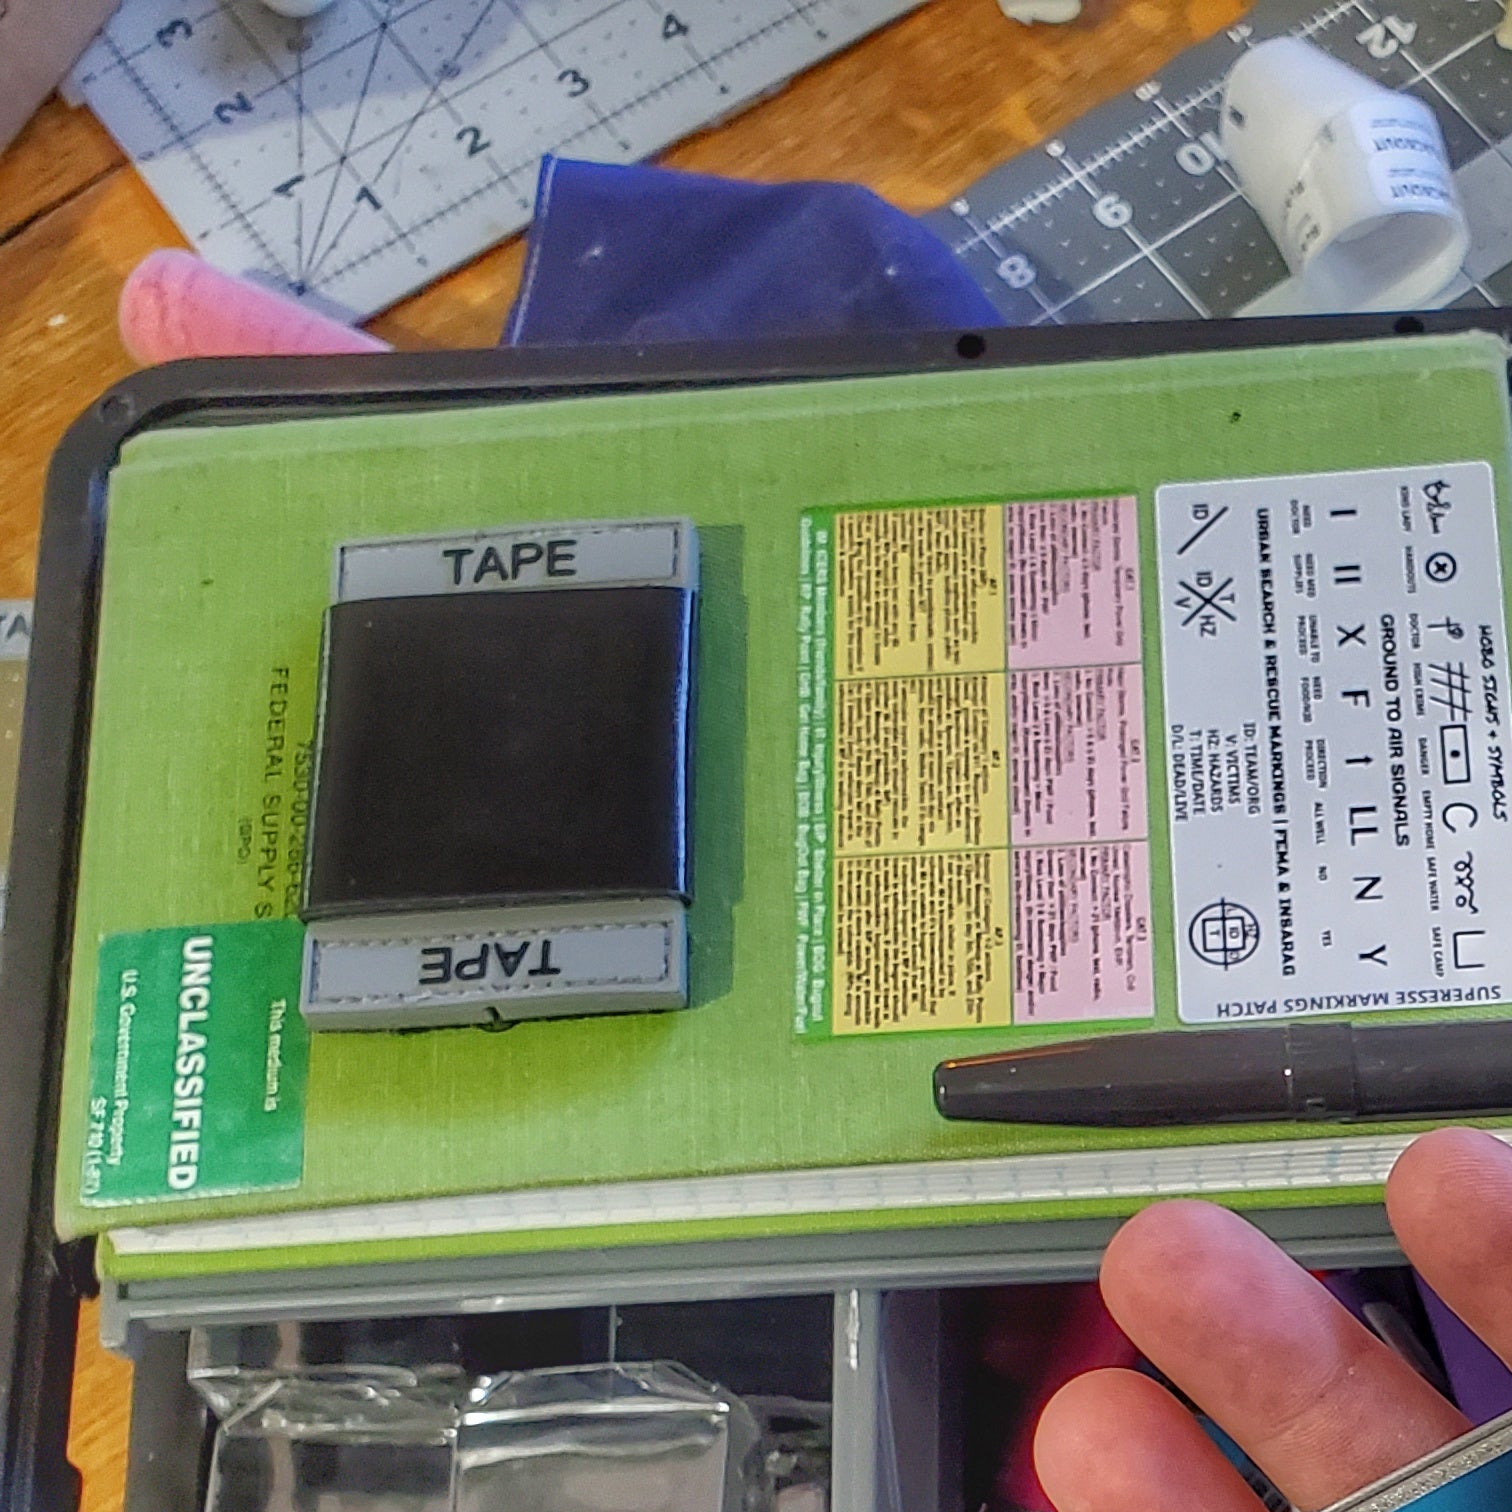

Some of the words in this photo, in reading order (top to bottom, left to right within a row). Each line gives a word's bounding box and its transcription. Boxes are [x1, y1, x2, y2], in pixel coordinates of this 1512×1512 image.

[156, 19, 194, 47] 3
[661, 14, 690, 41] 4
[557, 67, 592, 99] 3
[213, 92, 254, 124] 2
[457, 126, 491, 156] 2
[996, 254, 1036, 289] 8
[1192, 504, 1210, 521] ID
[1256, 508, 1272, 563] URBAN
[442, 539, 578, 586] TAPE
[1258, 568, 1277, 635] SEARCH
[1198, 615, 1218, 638] HZ
[1336, 623, 1367, 649] X
[1409, 613, 1421, 650] DOCTOR
[1380, 614, 1400, 692] GROUND
[1478, 625, 1496, 670] HOBO
[1264, 655, 1282, 722] RESCUE
[1311, 676, 1323, 700] NEED
[1341, 689, 1371, 709] F
[1482, 675, 1503, 726] SIGNS
[264, 667, 290, 783] FEDERAL
[1385, 696, 1402, 723] TO
[1171, 724, 1186, 750] D/L:
[1207, 729, 1220, 752] HZ:
[1242, 722, 1257, 741] ID:
[1387, 727, 1405, 759] AIR
[1269, 725, 1287, 815] MARKINGS
[1304, 739, 1316, 781] PROCEED
[1316, 738, 1328, 789] DIRECTION
[1418, 737, 1430, 776] DANGER
[1172, 752, 1188, 823] DEAD/LIVE
[1189, 744, 1206, 816] TIME/DATE
[1208, 753, 1222, 813] HAZARDS
[1226, 748, 1241, 805] VICTIMS
[1244, 744, 1260, 815] TEAM/ORG
[1486, 745, 1508, 822] SYMBOLS
[1314, 801, 1325, 819] ALL
[1390, 763, 1410, 848] SIGNALS
[1420, 790, 1433, 820] EMPTY
[255, 795, 282, 893] SUPPLY
[1315, 820, 1327, 845] WELL
[1423, 822, 1436, 850] HOME
[1273, 828, 1291, 877] FEMA
[1426, 856, 1438, 878] SAFE
[1318, 865, 1329, 881] NO
[1353, 876, 1383, 902] N
[1428, 880, 1440, 912] WATER
[1278, 898, 1295, 977] INSARAG
[1321, 930, 1332, 948] YES
[1431, 927, 1442, 949] SAFE
[419, 939, 562, 985] TAPE
[1357, 944, 1388, 967] Y
[1432, 951, 1445, 978] CAMP
[119, 969, 138, 1000] U.S.
[1284, 990, 1390, 1011] MARKINGS
[1397, 985, 1502, 1005] SUPERESSE
[268, 998, 287, 1032] This
[1216, 996, 1279, 1017] PATCH
[113, 1003, 137, 1098] Government
[167, 934, 214, 1190] UNCLASSIFIED
[264, 1034, 284, 1093] medium
[264, 1096, 279, 1111] is
[106, 1099, 130, 1166] Property
